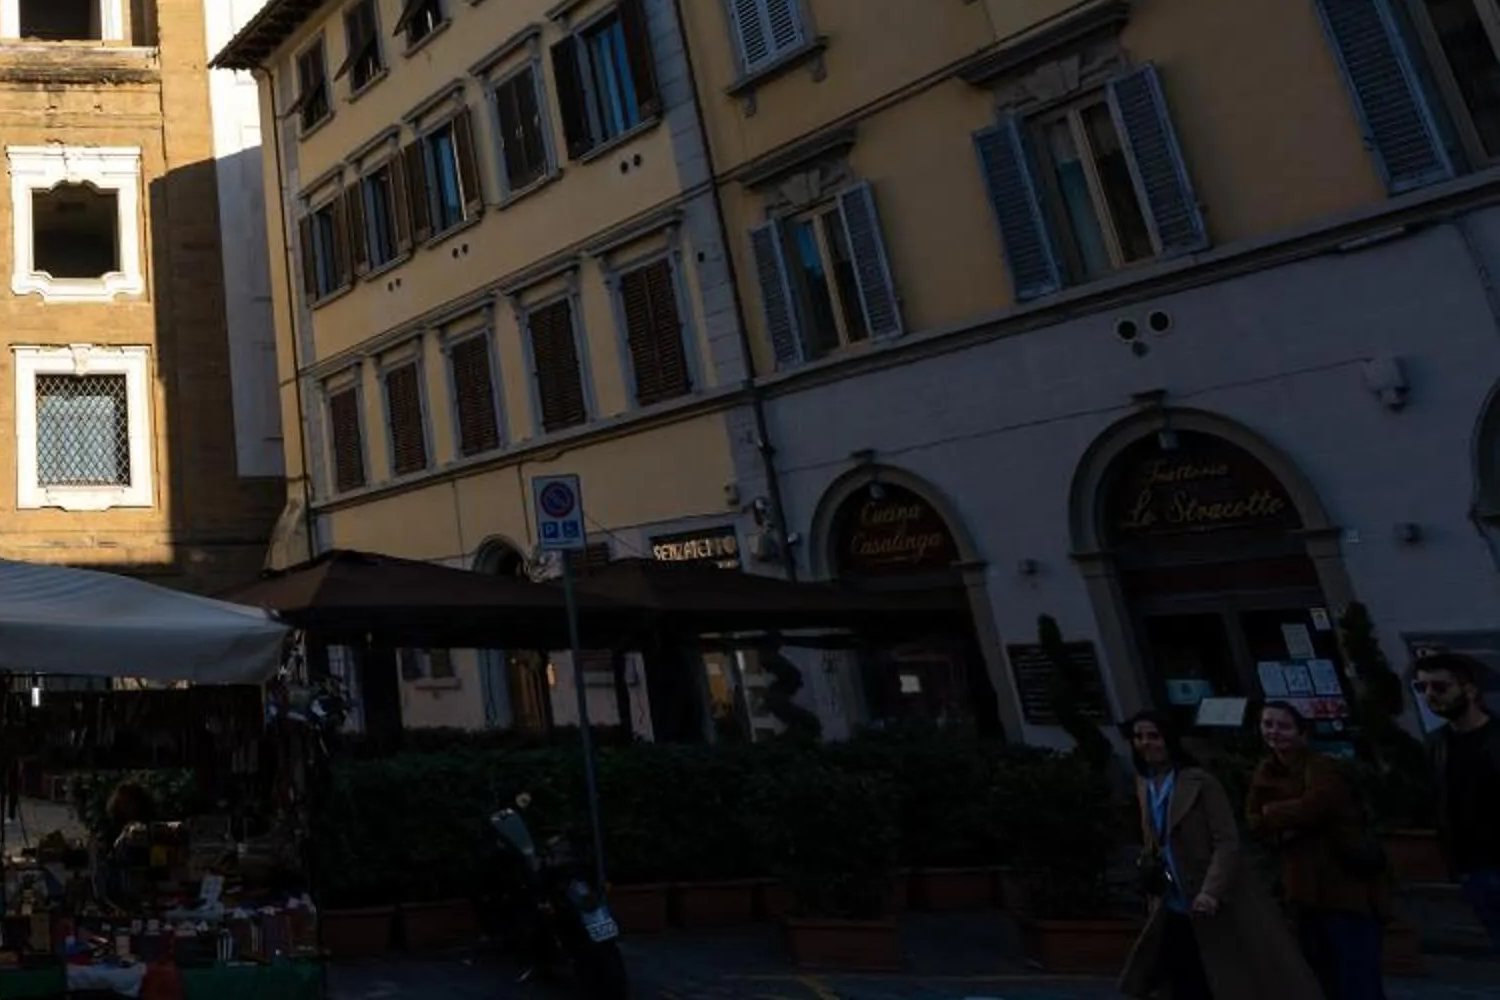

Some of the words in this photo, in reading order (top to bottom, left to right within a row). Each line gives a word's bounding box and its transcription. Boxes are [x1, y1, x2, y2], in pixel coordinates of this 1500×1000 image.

[860, 500, 923, 527] Cucina
[1166, 488, 1286, 523] Stracotto
[849, 527, 945, 564] Casalinga
